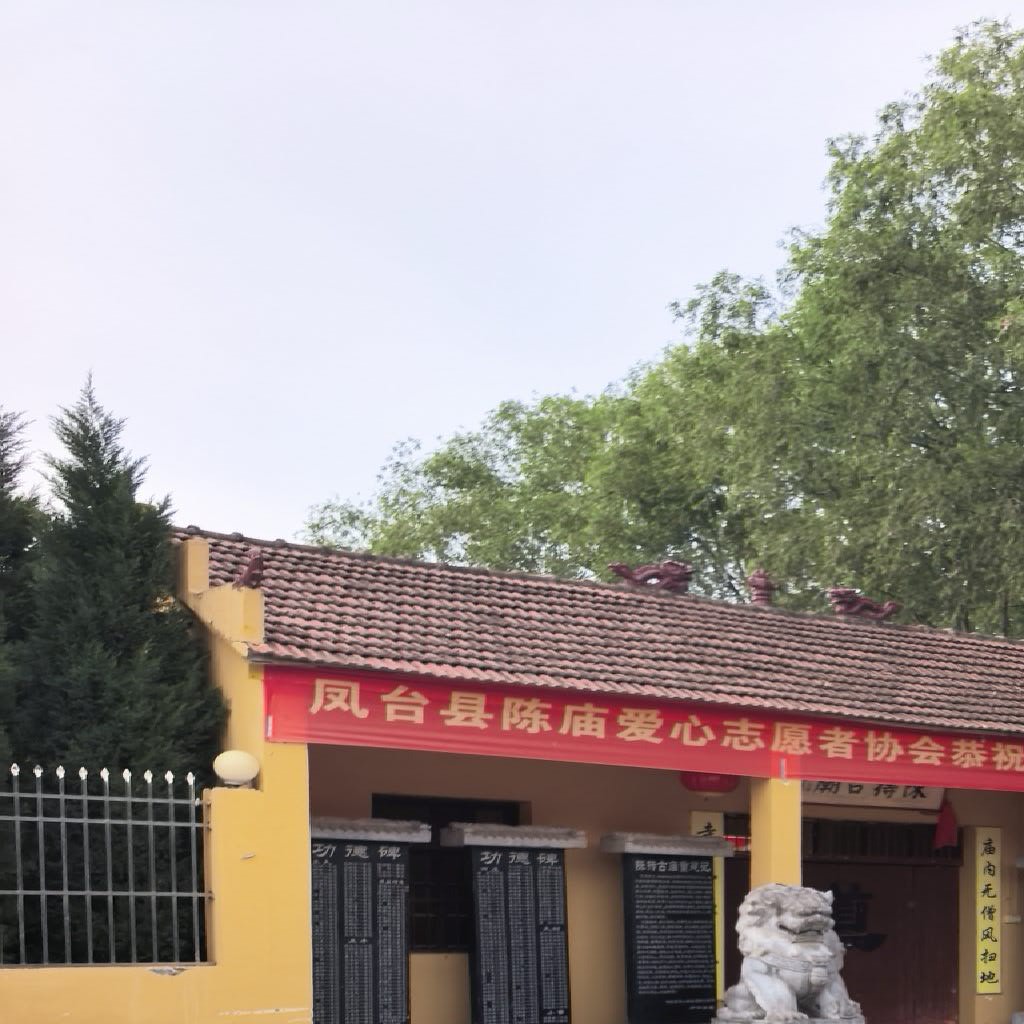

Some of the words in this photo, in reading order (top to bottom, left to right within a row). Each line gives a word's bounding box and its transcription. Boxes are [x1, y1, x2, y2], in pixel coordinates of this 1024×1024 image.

[979, 837, 1000, 984] 庙内无僧风扫地
